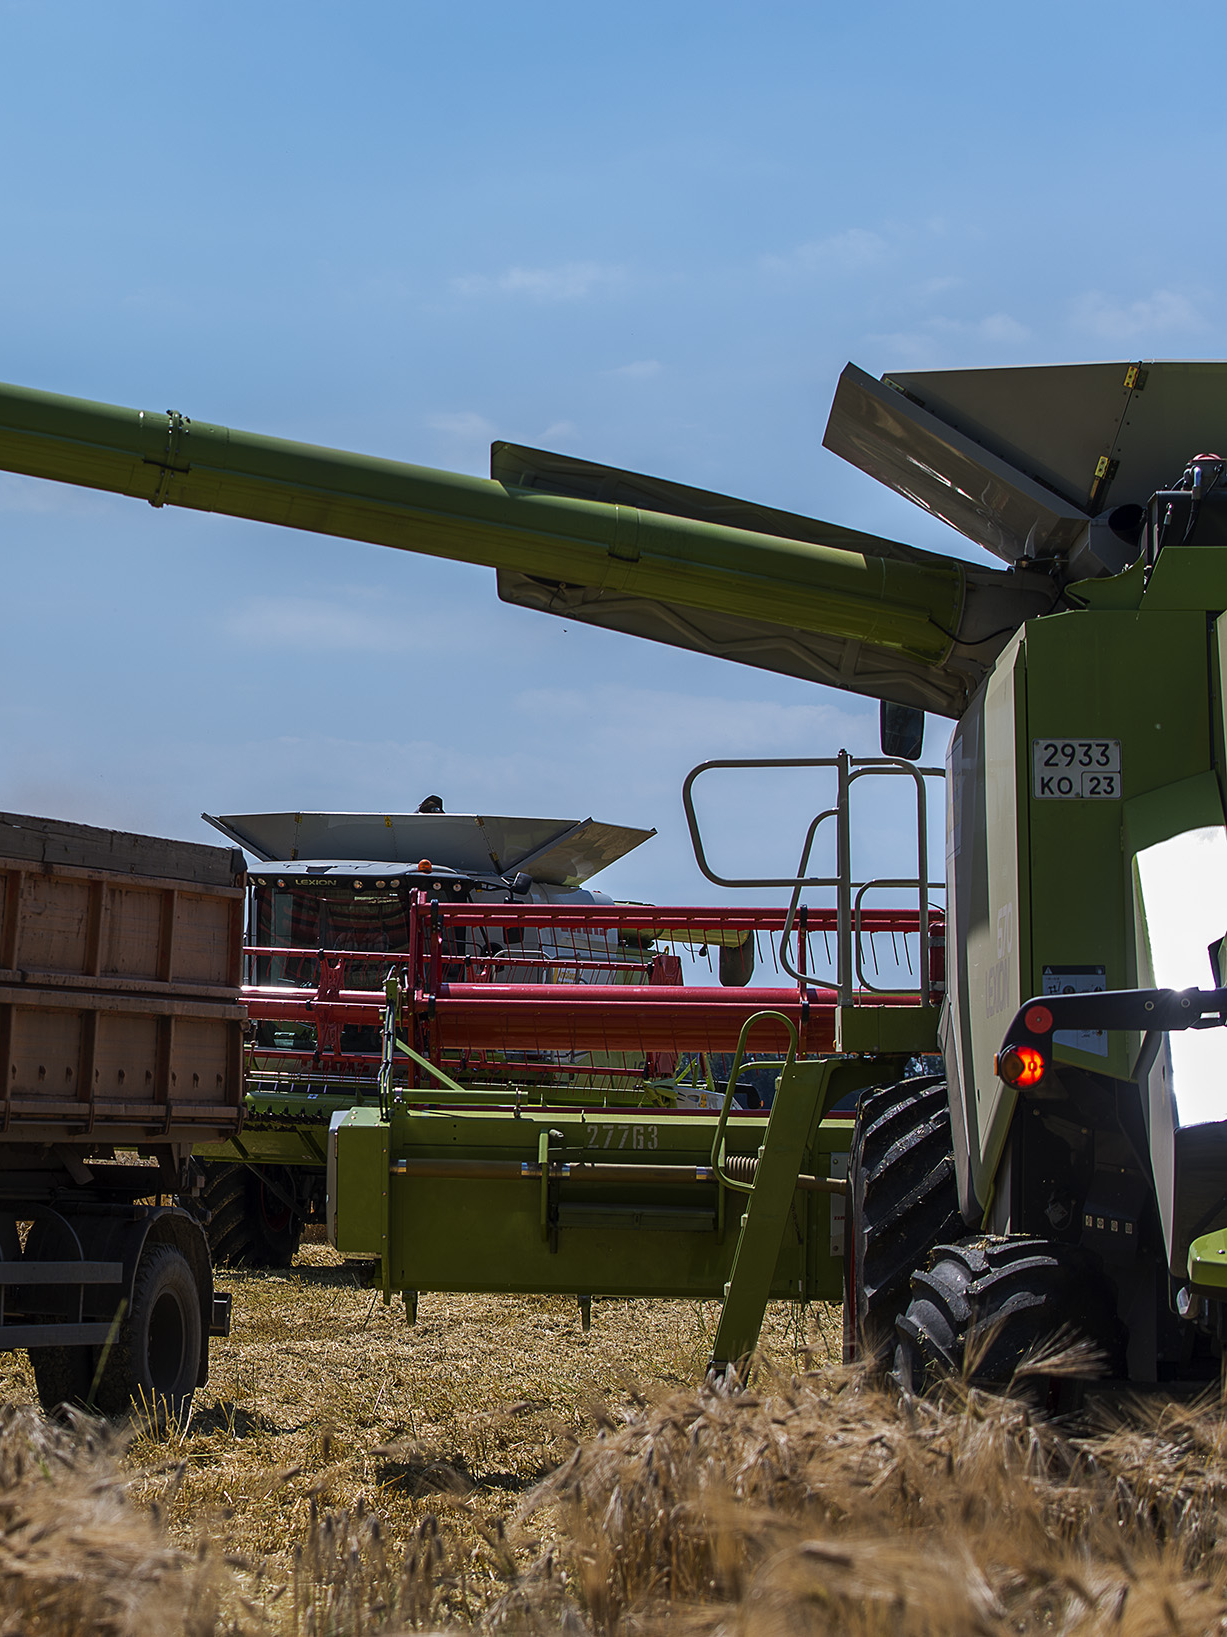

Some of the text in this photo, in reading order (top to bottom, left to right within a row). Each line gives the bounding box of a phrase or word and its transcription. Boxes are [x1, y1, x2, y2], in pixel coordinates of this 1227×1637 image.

[1043, 743, 1110, 767] 2933
[1088, 776, 1115, 796] 23
[295, 879, 337, 887] LEXION
